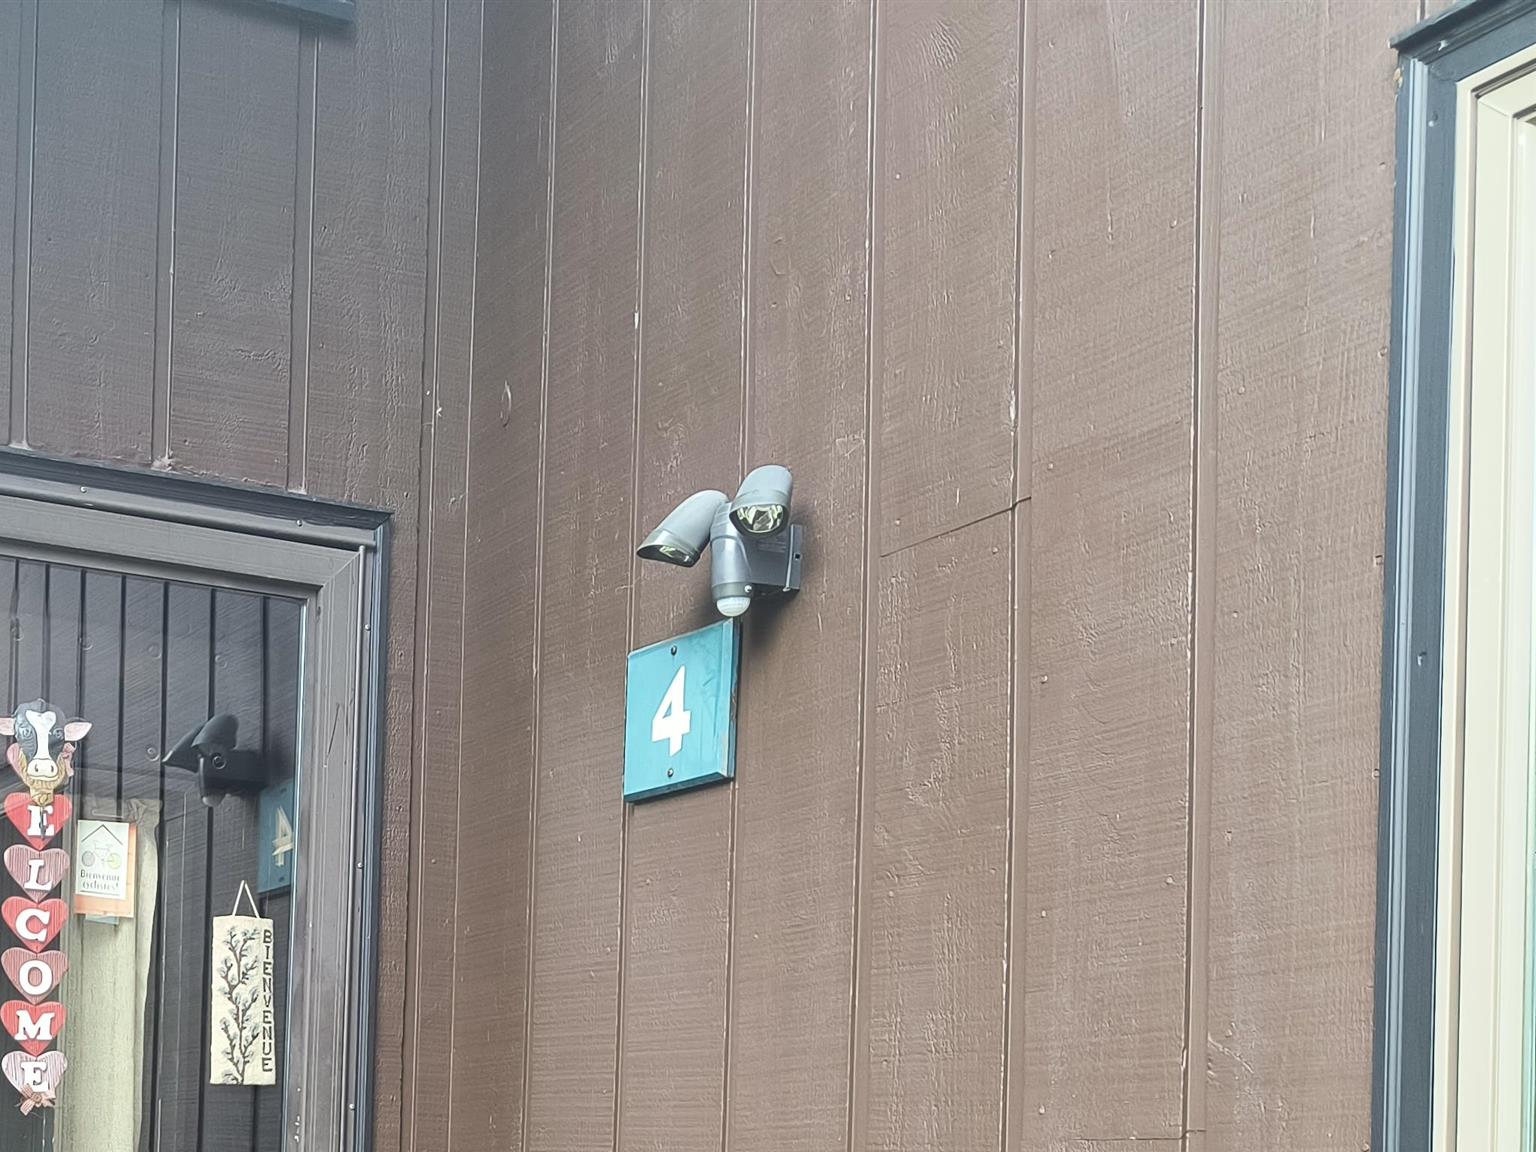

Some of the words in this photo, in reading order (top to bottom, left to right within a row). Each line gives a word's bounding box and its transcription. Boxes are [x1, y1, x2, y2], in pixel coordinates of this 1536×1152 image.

[651, 665, 692, 757] 4
[14, 803, 56, 1094] ELCOME
[261, 929, 273, 1073] BIENVENUE
